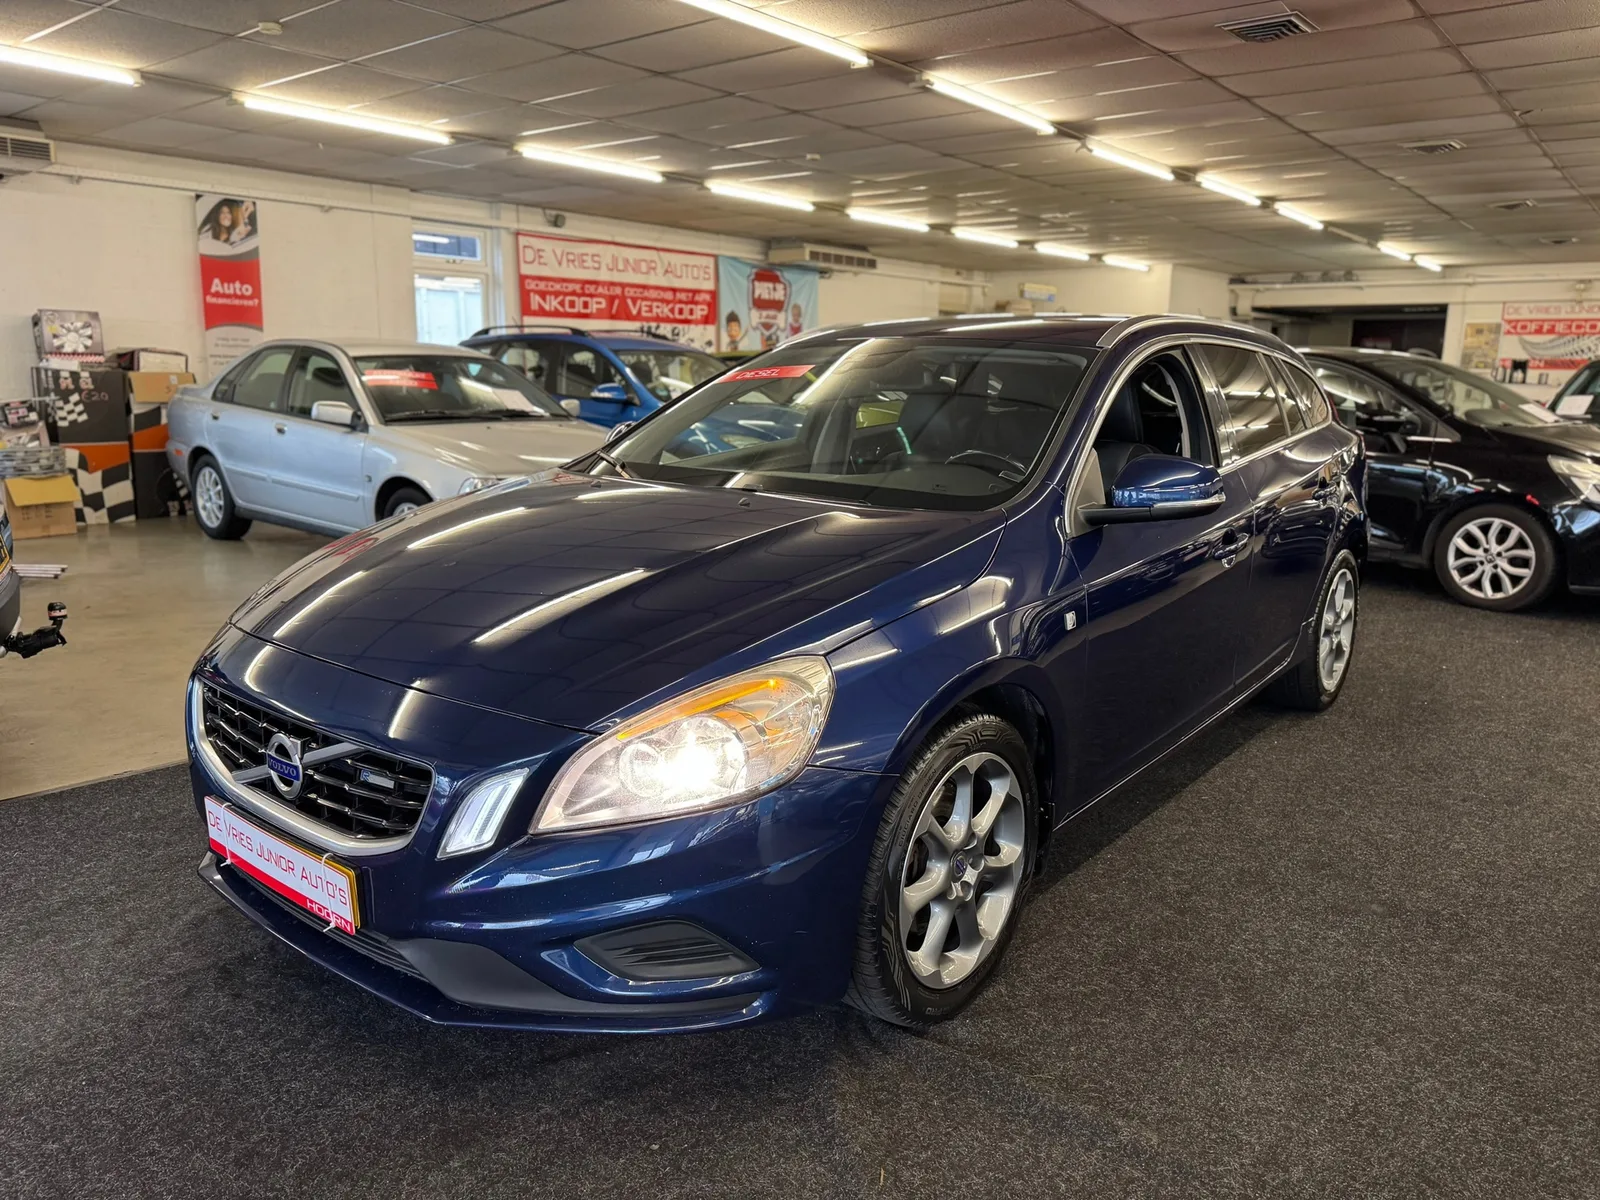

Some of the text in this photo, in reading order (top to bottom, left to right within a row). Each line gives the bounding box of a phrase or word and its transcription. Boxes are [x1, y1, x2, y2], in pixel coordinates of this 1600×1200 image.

[523, 244, 712, 281] DE VRIES JUNIOR AUTO'S
[210, 277, 253, 296] Auto
[524, 278, 583, 294] GOEDKOPE
[584, 284, 622, 296] DEALER
[205, 294, 260, 307] financieren?
[530, 292, 709, 320] INKOOP / VERKOOP
[1506, 305, 1522, 316] DE
[736, 368, 780, 379] DIESEL
[269, 759, 297, 777] VOLVO
[208, 810, 348, 906] DE VRIES JUNIOR AUTO'S
[306, 899, 351, 932] HOORN
